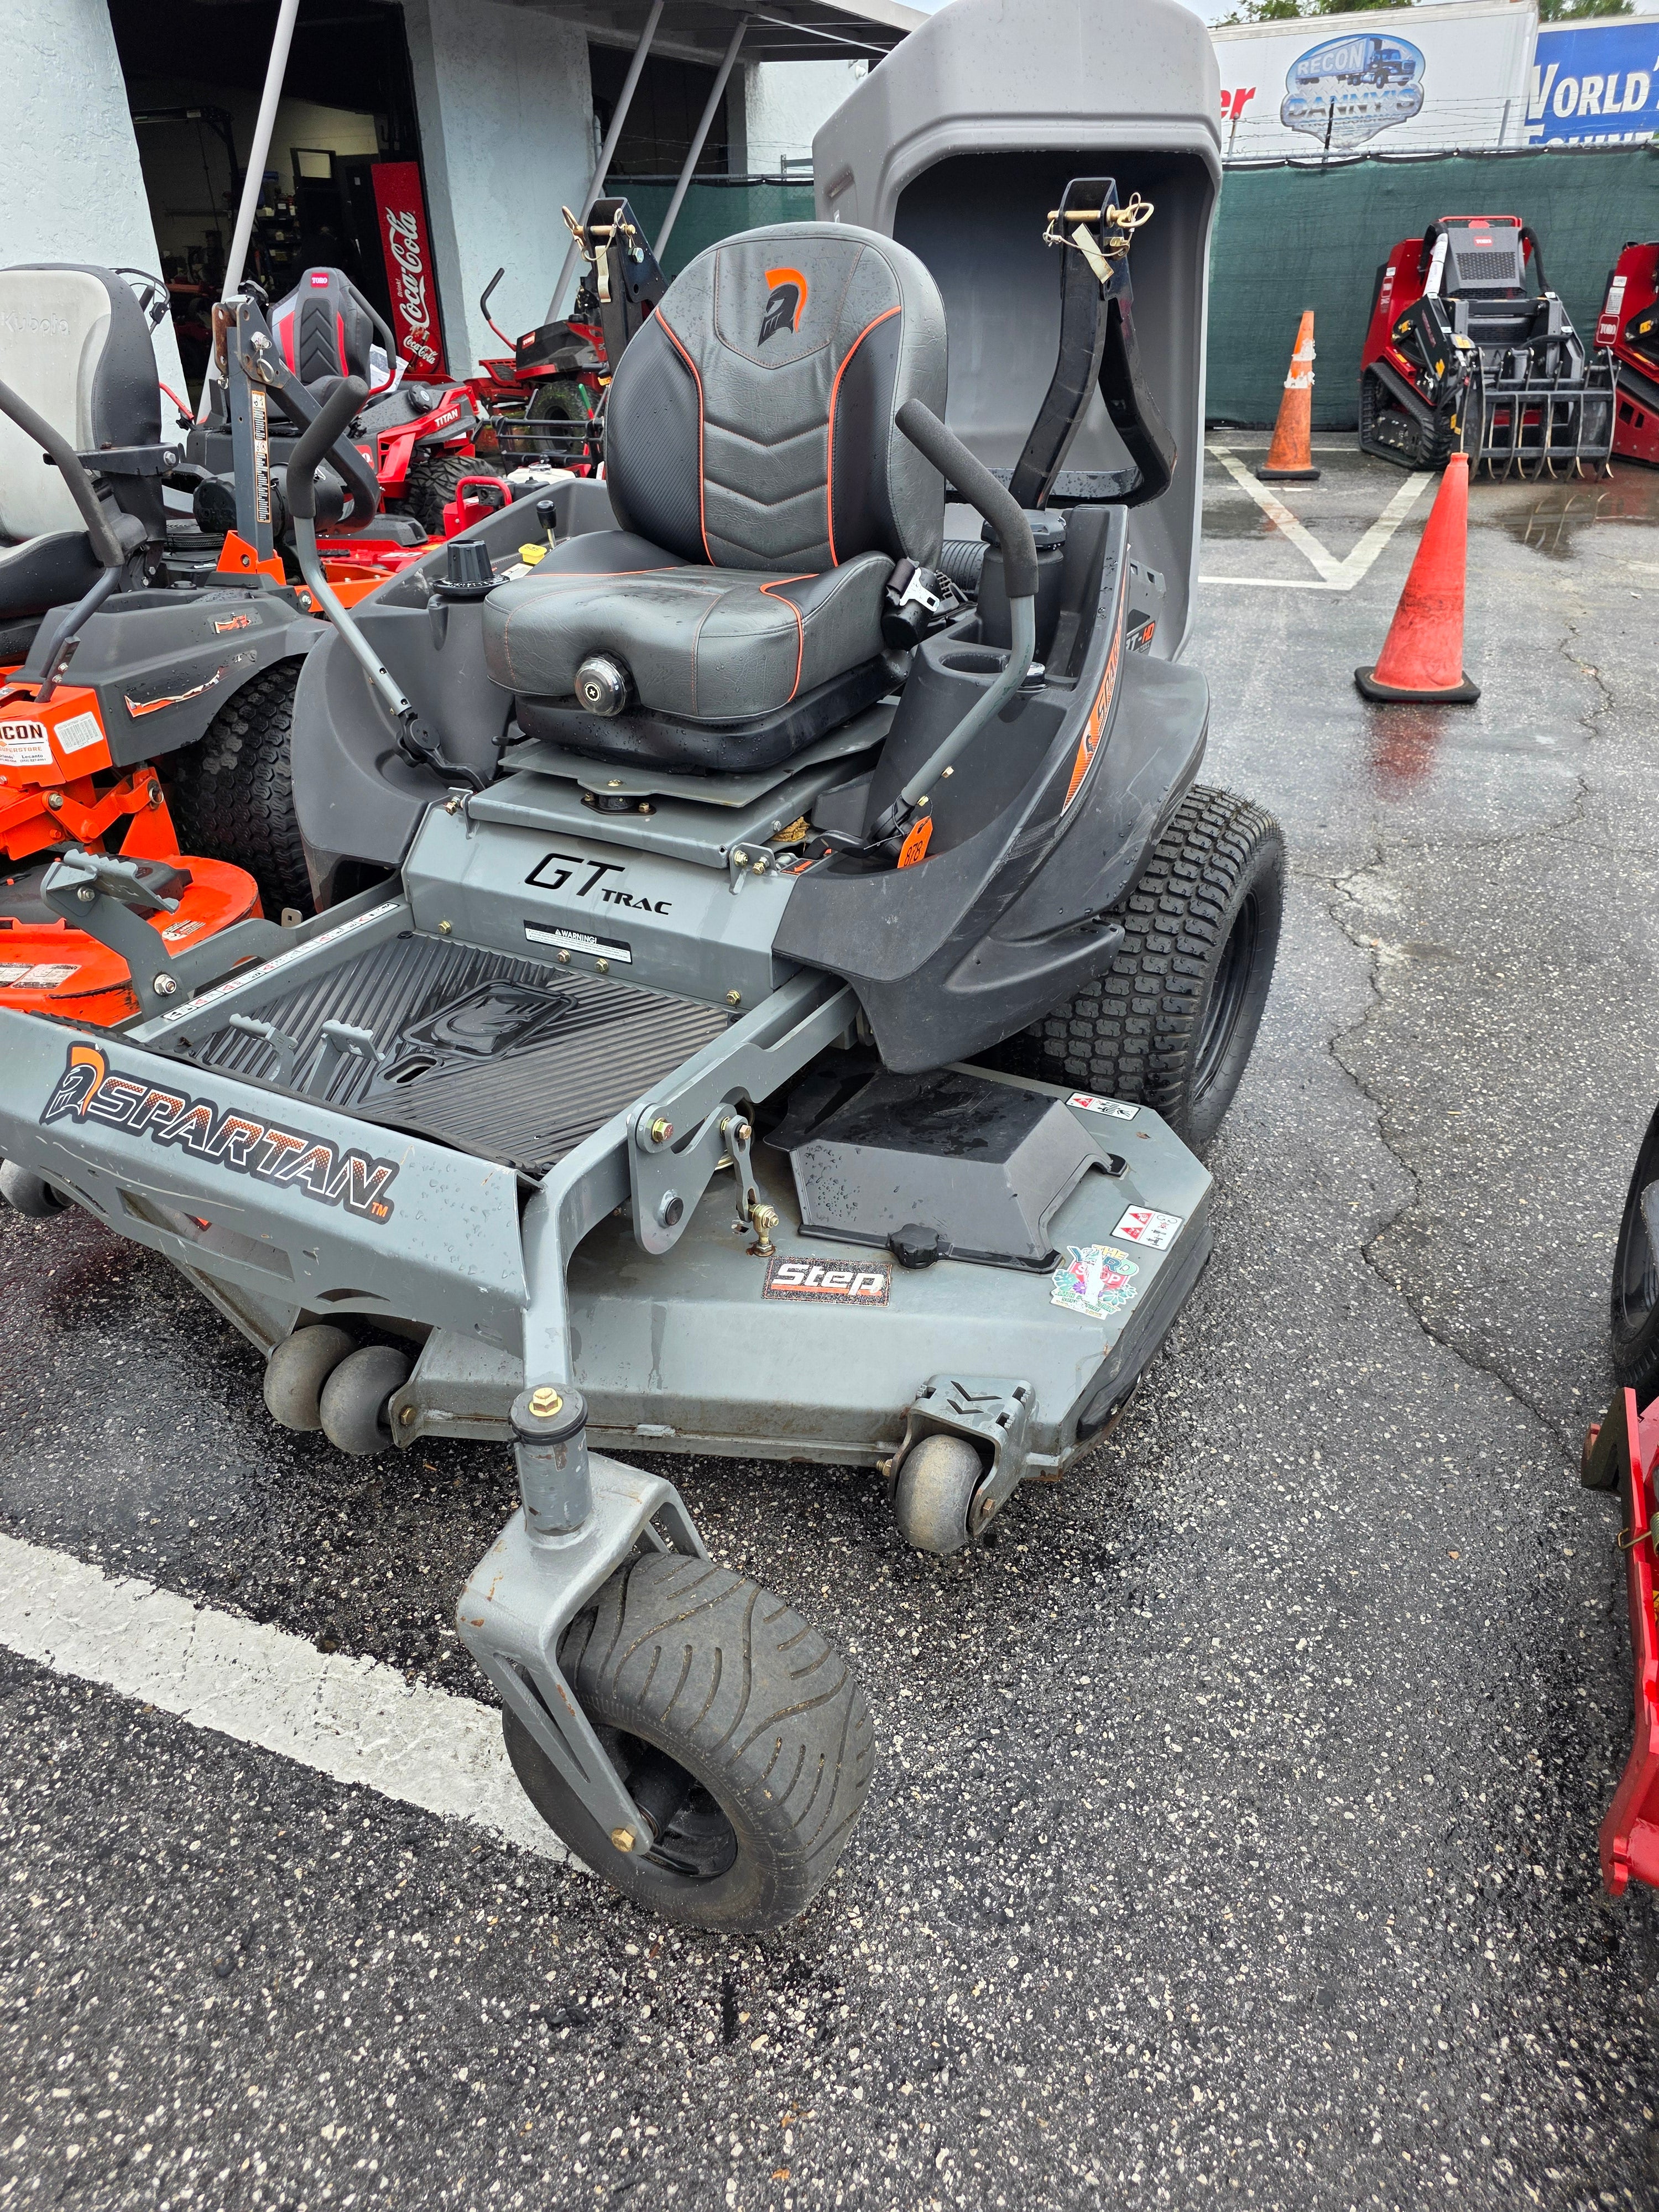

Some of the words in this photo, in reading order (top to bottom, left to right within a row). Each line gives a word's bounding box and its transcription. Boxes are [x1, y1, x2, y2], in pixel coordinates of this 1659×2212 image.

[1297, 42, 1364, 75] RECON
[0, 310, 70, 336] Kubota
[1600, 324, 1616, 335] TORO
[434, 409, 458, 427] TITAN
[0, 724, 44, 740] CON
[904, 840, 923, 867] 878
[524, 853, 626, 897] GT
[601, 888, 672, 915] TRAC
[561, 930, 597, 944] WARNING!
[87, 1076, 393, 1209] SPARTAN
[371, 1202, 388, 1217] TM
[1069, 1246, 1138, 1276] YRD
[1093, 1245, 1126, 1258] THE
[771, 1263, 884, 1296] Step
[1076, 1265, 1121, 1284] SOP
[1052, 1290, 1076, 1298] AWN
